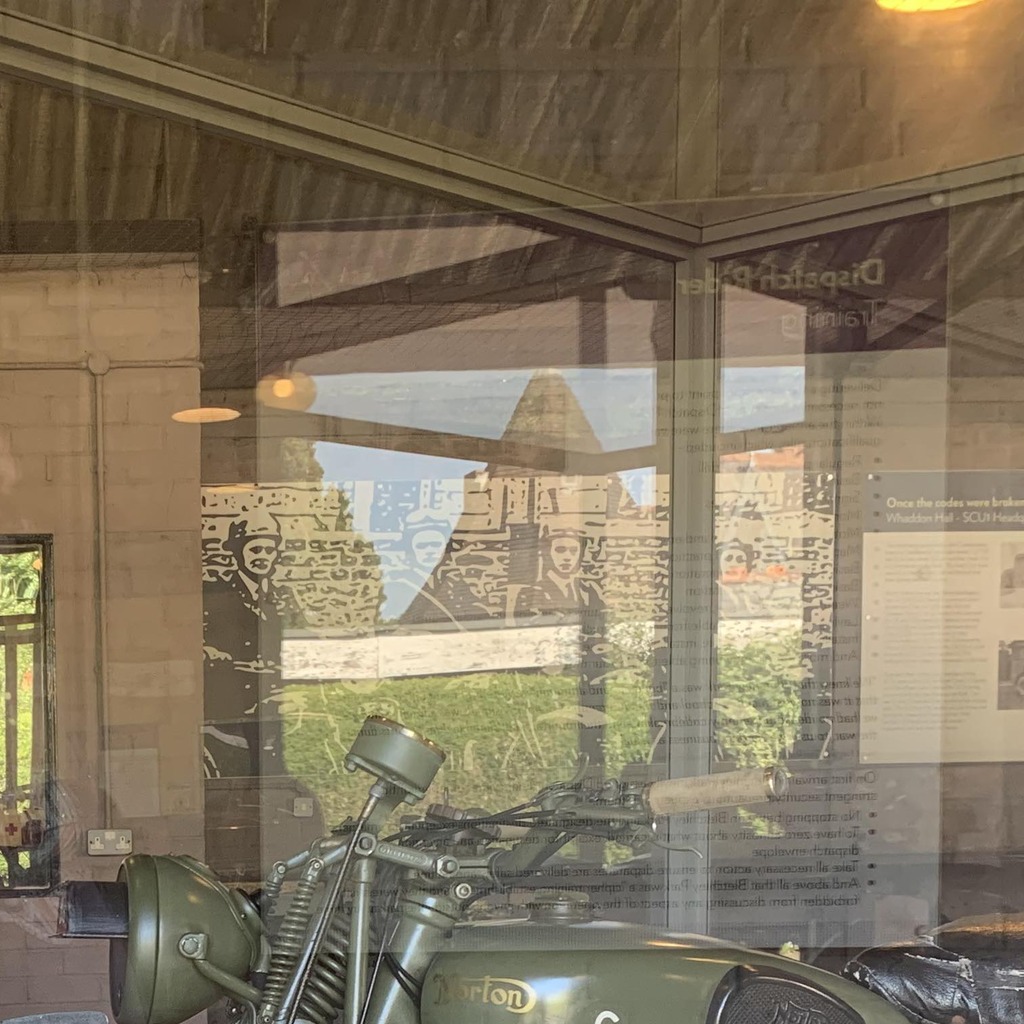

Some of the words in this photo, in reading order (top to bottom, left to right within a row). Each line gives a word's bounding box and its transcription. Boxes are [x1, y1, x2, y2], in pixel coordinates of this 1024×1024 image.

[886, 496, 914, 508] Once
[916, 496, 933, 508] the
[935, 496, 964, 508] codes
[966, 500, 989, 508] were
[886, 512, 933, 523] Whaddon
[935, 512, 955, 523] Hall
[432, 974, 537, 1014] Norton
